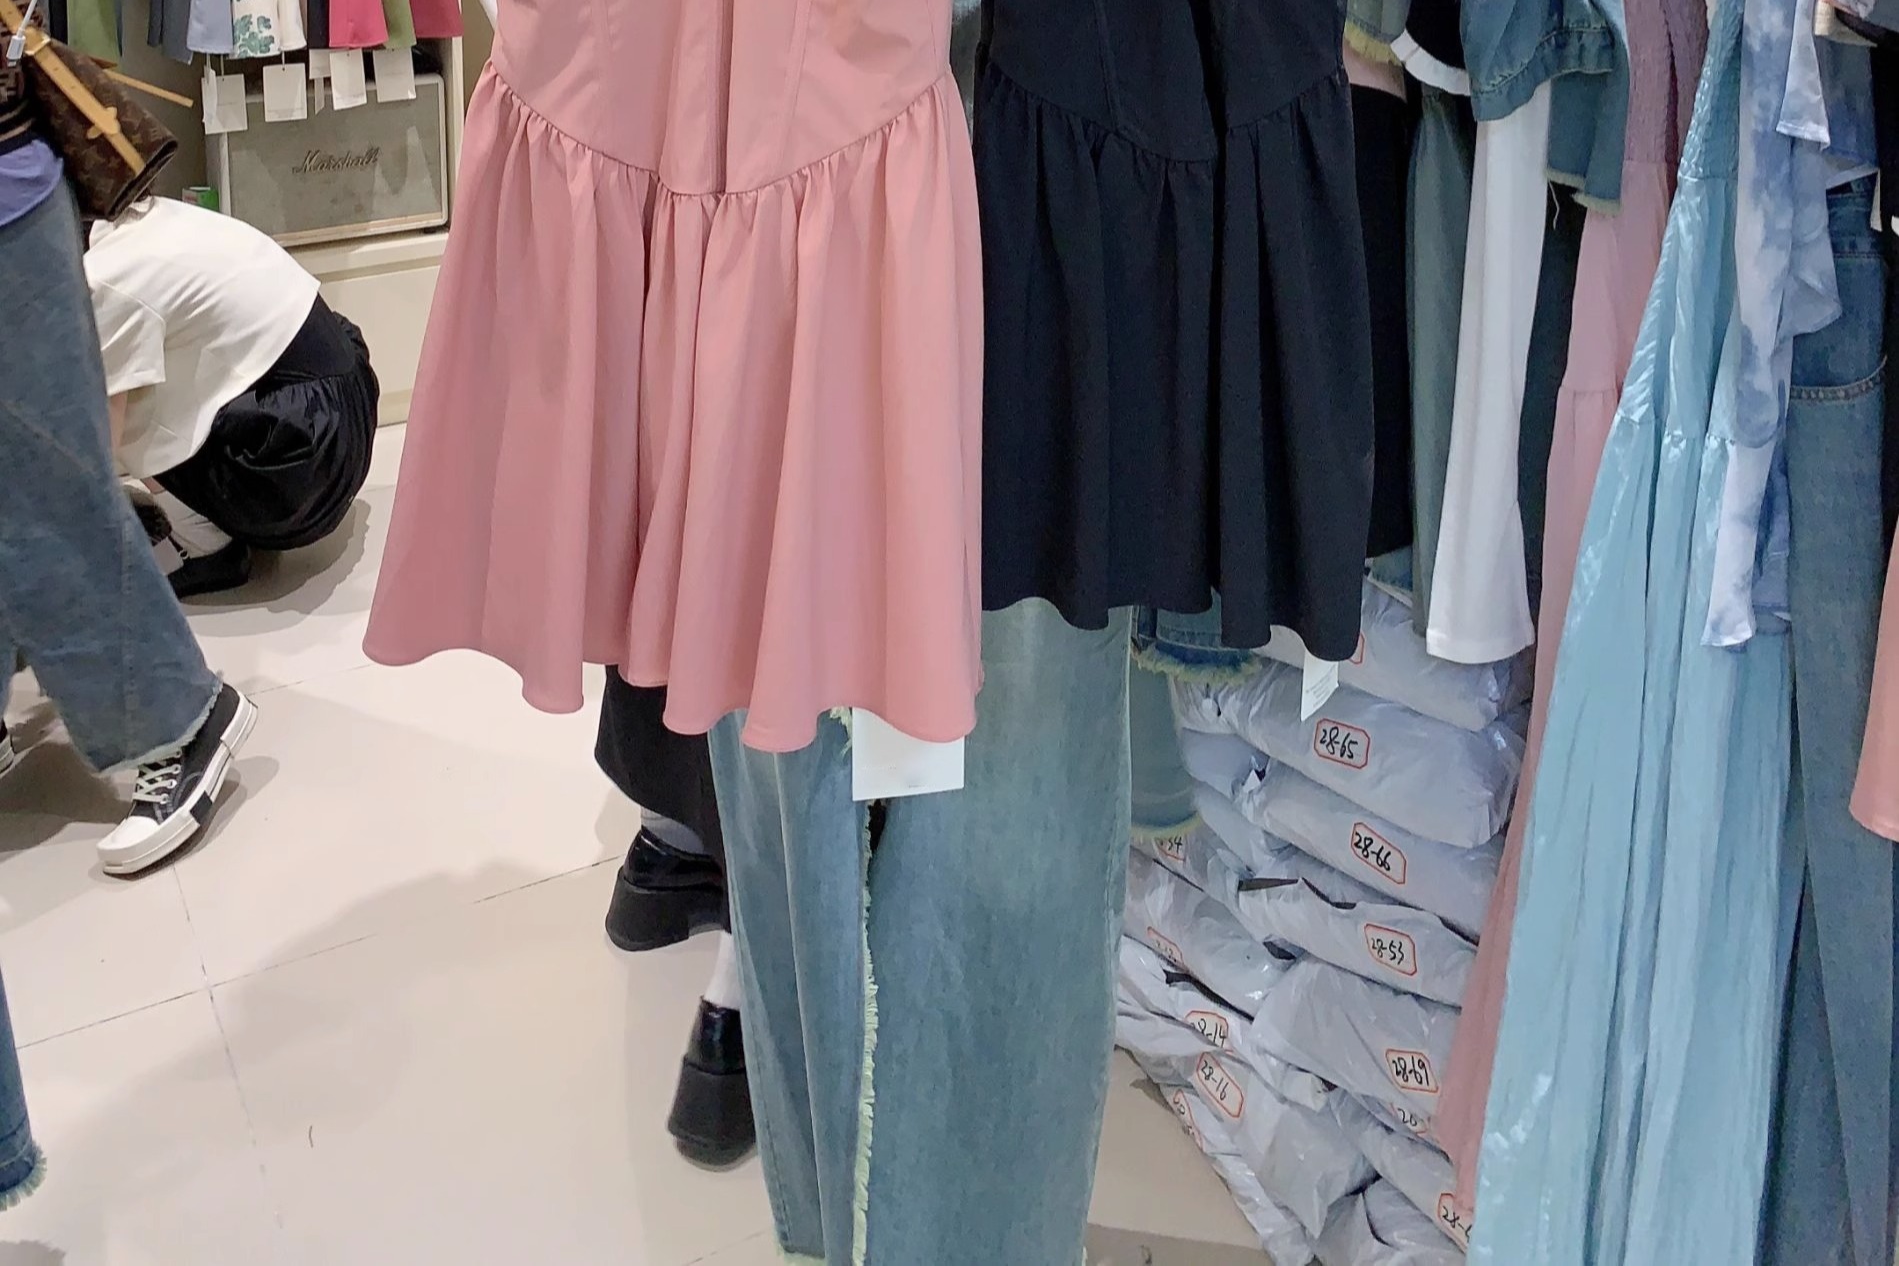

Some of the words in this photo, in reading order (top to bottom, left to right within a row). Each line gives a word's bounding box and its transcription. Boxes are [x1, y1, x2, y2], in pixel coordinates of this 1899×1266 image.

[292, 147, 380, 174] Marshall
[1319, 726, 1359, 760] 28-65
[1353, 831, 1392, 872] 28-66
[1370, 937, 1405, 966] 28-53
[1201, 1059, 1230, 1101] 28-16
[1392, 1055, 1430, 1087] 28-69
